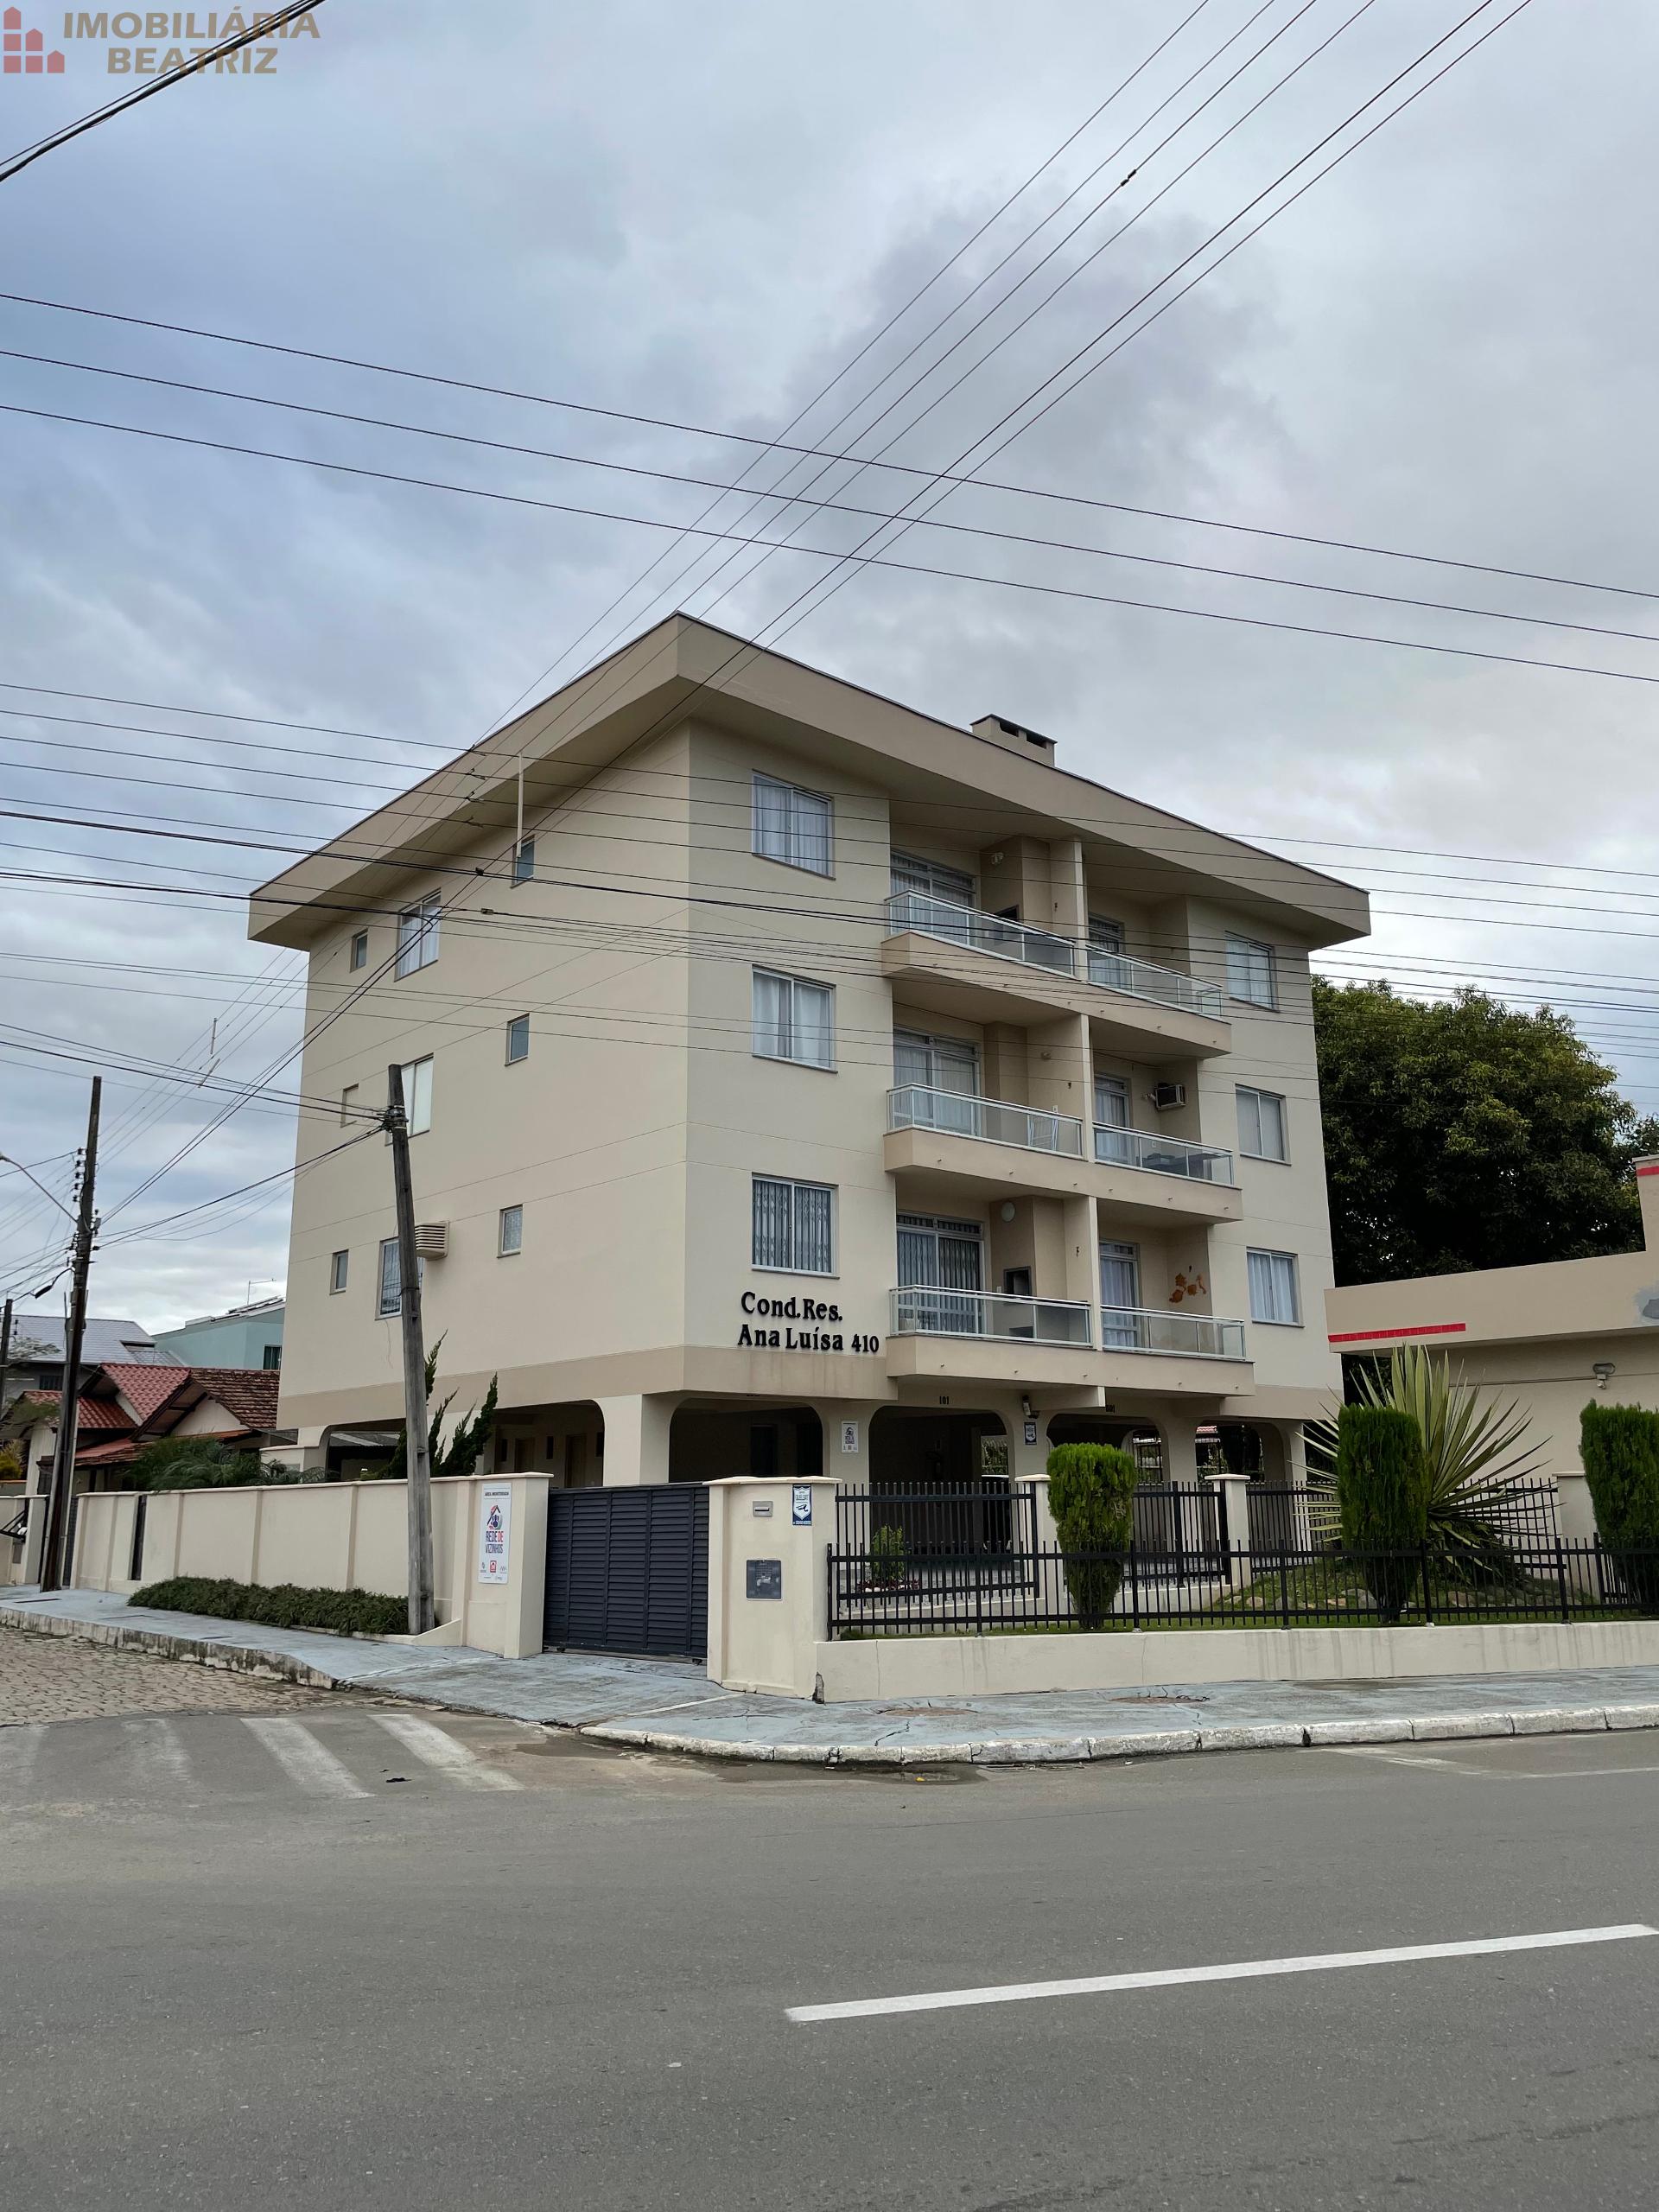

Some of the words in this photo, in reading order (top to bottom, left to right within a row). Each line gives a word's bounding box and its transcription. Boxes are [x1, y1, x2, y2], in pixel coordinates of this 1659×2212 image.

[737, 1324, 781, 1347] Ana
[785, 1326, 844, 1351] Luísa
[851, 1333, 880, 1353] 410
[485, 1530, 498, 1542] REDE
[497, 1530, 504, 1542] DE
